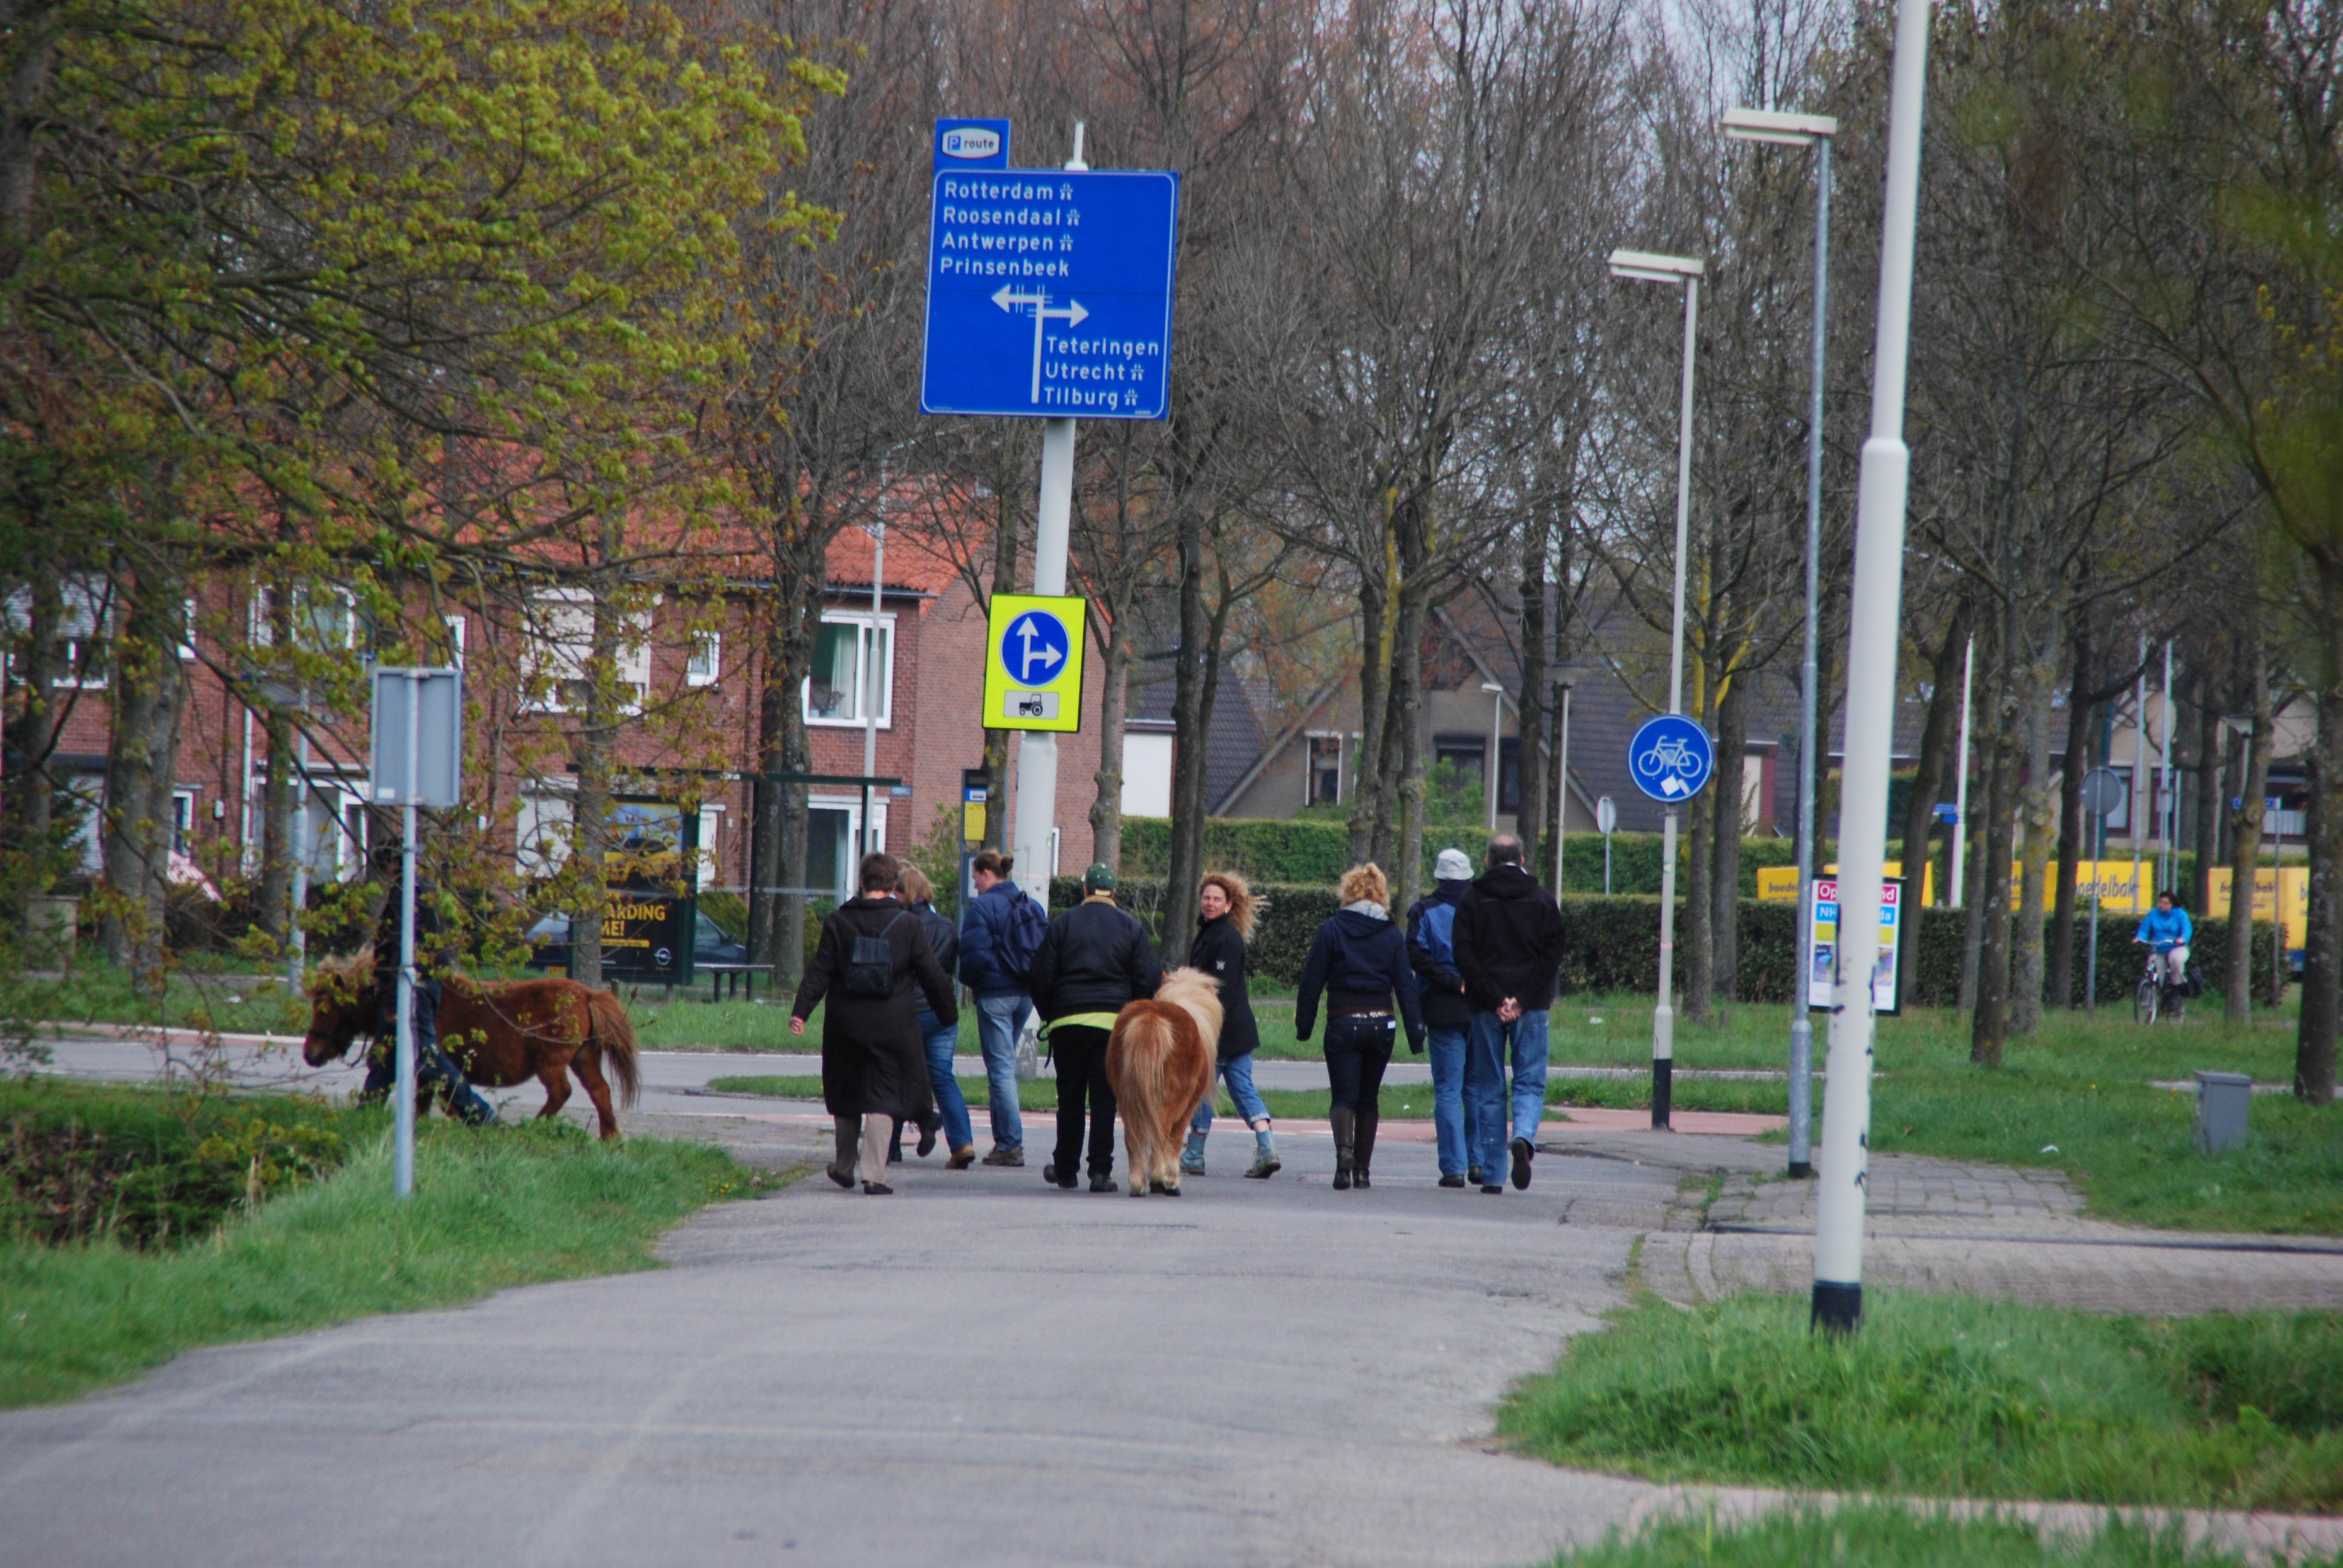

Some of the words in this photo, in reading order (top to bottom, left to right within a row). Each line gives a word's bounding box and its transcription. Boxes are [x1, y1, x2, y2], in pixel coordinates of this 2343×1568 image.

[964, 139, 994, 149] route
[945, 181, 1054, 200] Rotterdam
[943, 206, 1061, 226] Roosendaal
[942, 232, 1054, 253] Antwerpen
[940, 257, 1069, 277] Prinsenbeek
[1047, 336, 1159, 361] Teteringen
[1046, 362, 1126, 381] Utrecht
[1044, 387, 1118, 411] Tilburg
[1820, 884, 1838, 901] Op
[603, 902, 666, 921] ARDING
[601, 920, 625, 936] ME!
